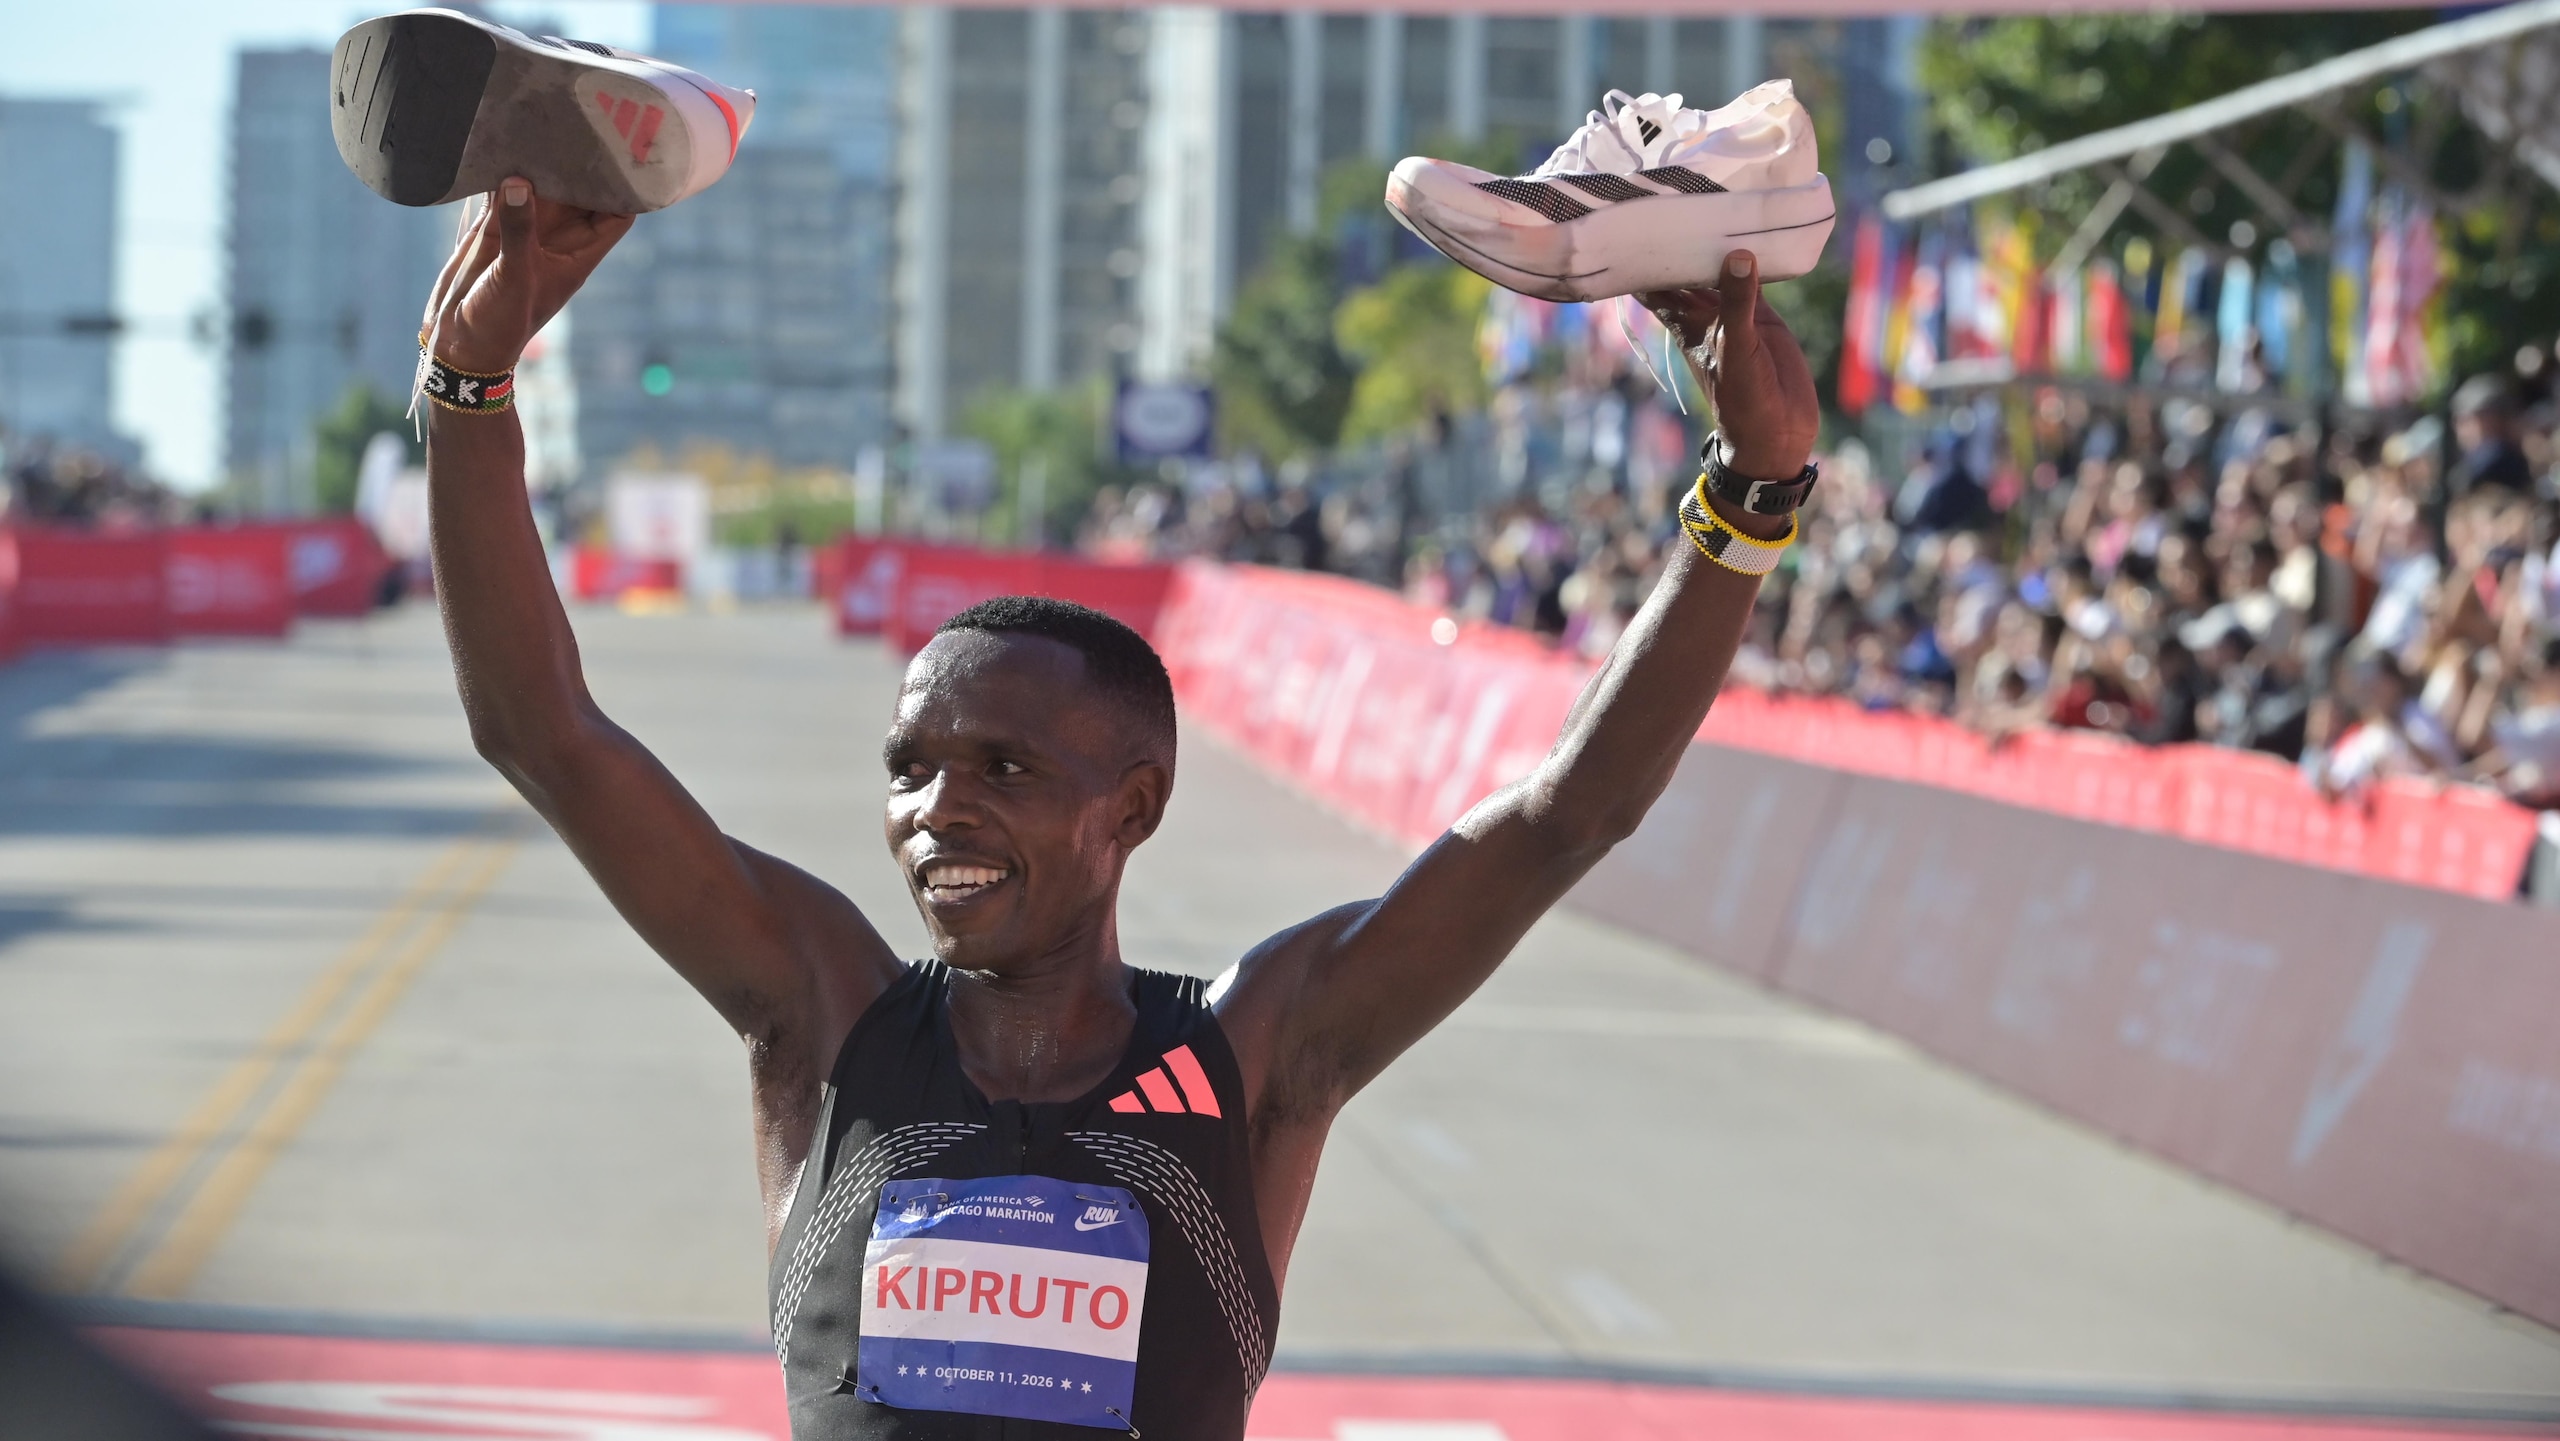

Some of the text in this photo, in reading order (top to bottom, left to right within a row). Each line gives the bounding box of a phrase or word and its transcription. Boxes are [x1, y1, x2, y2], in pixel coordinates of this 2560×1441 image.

[937, 1200, 961, 1210] BANK
[976, 1196, 1022, 1206] AMERICA
[933, 1205, 1054, 1224] CHICAGO MARATHON
[1083, 1206, 1120, 1222] RUN
[876, 1265, 1129, 1330] KIPRUTO
[935, 1366, 1054, 1388] OCTOBER 11, 2026
